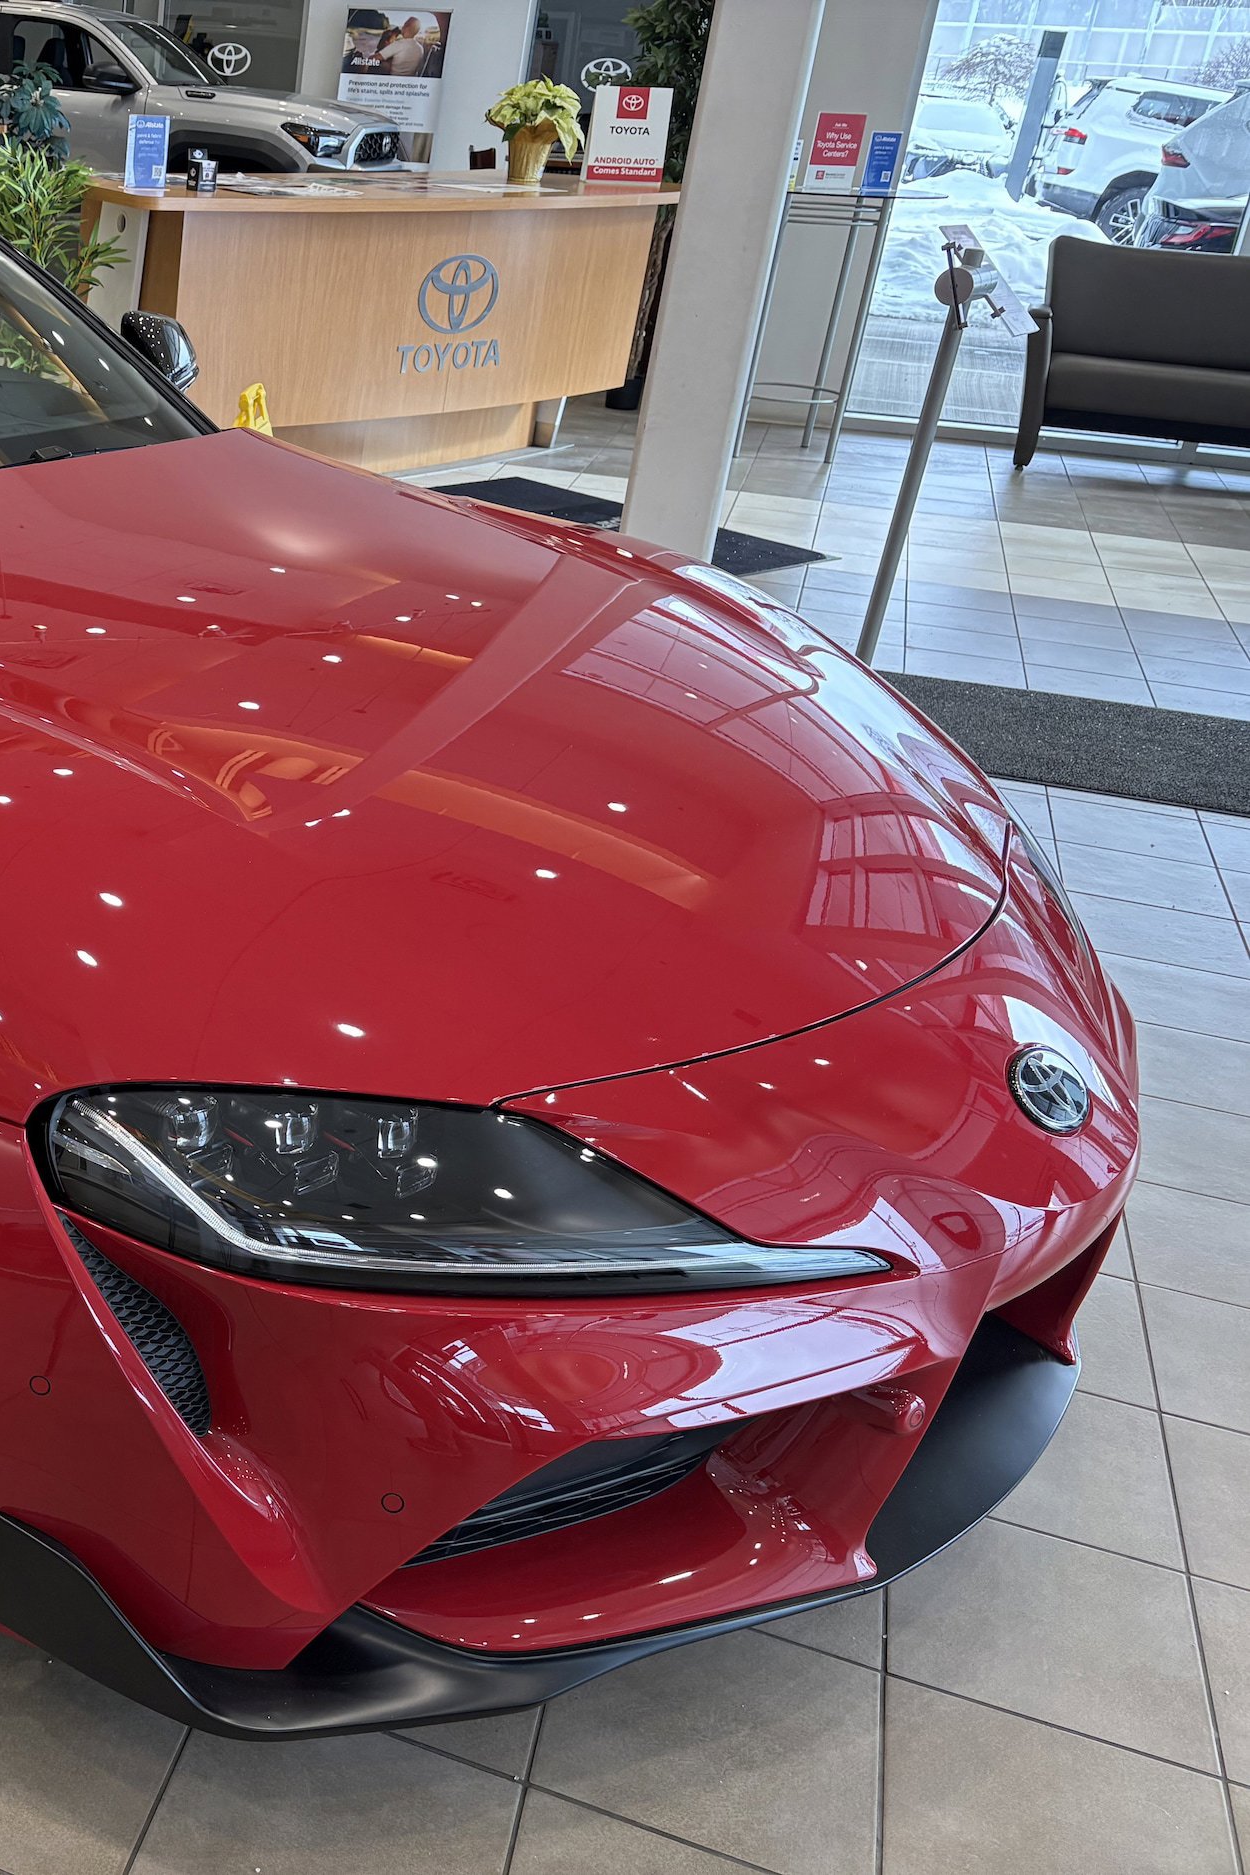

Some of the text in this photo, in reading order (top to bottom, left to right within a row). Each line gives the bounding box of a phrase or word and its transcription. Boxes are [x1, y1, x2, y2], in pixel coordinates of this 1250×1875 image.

[351, 57, 381, 66] Allstate
[609, 126, 650, 135] TOYOTA
[826, 131, 853, 141] Why Use
[816, 140, 858, 150] Toyota Service
[822, 149, 850, 158] Centers?
[593, 156, 632, 165] ANDROID
[593, 166, 657, 176] Comes Standard
[397, 338, 500, 375] TOYOTA
